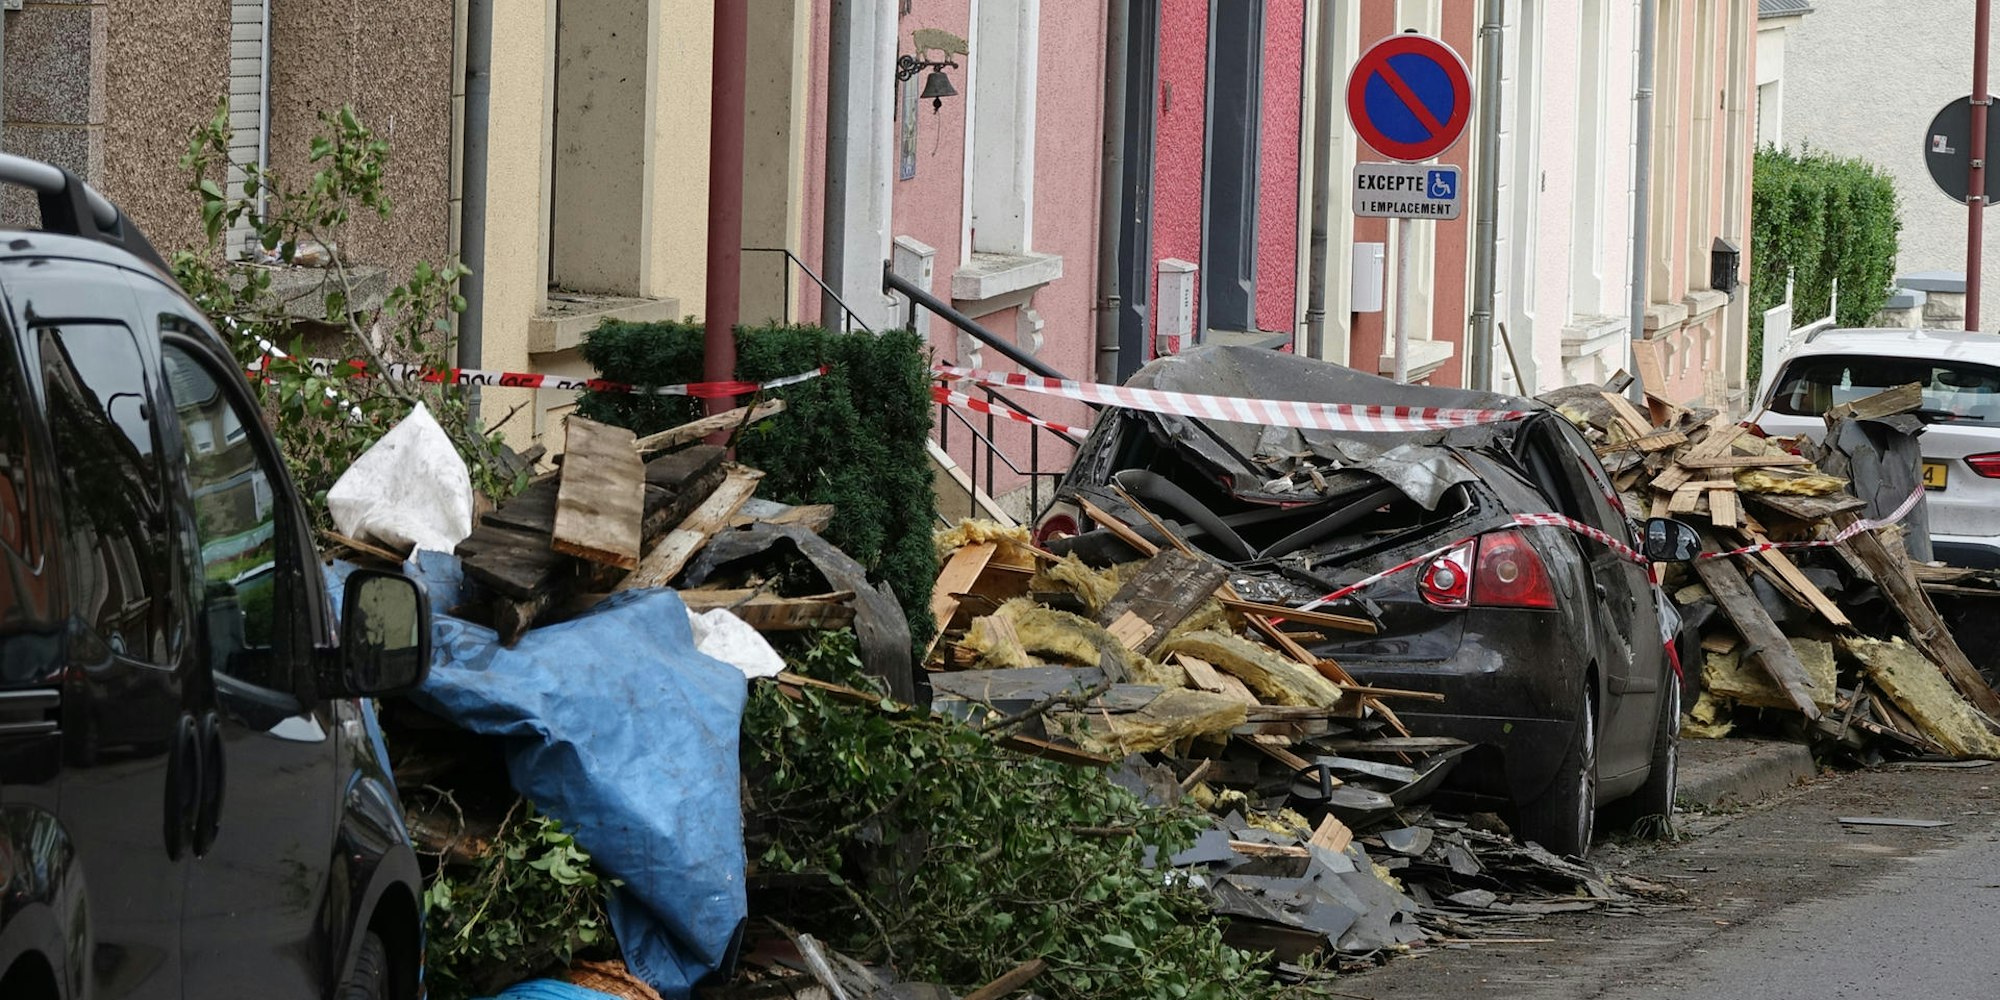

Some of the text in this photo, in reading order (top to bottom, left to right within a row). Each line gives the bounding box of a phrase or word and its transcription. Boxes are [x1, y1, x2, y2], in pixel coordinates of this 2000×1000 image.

[1358, 175, 1424, 192] EXCEPTE
[1361, 201, 1451, 215] 1 EMPLACEMENT
[1923, 467, 1934, 483] 4
